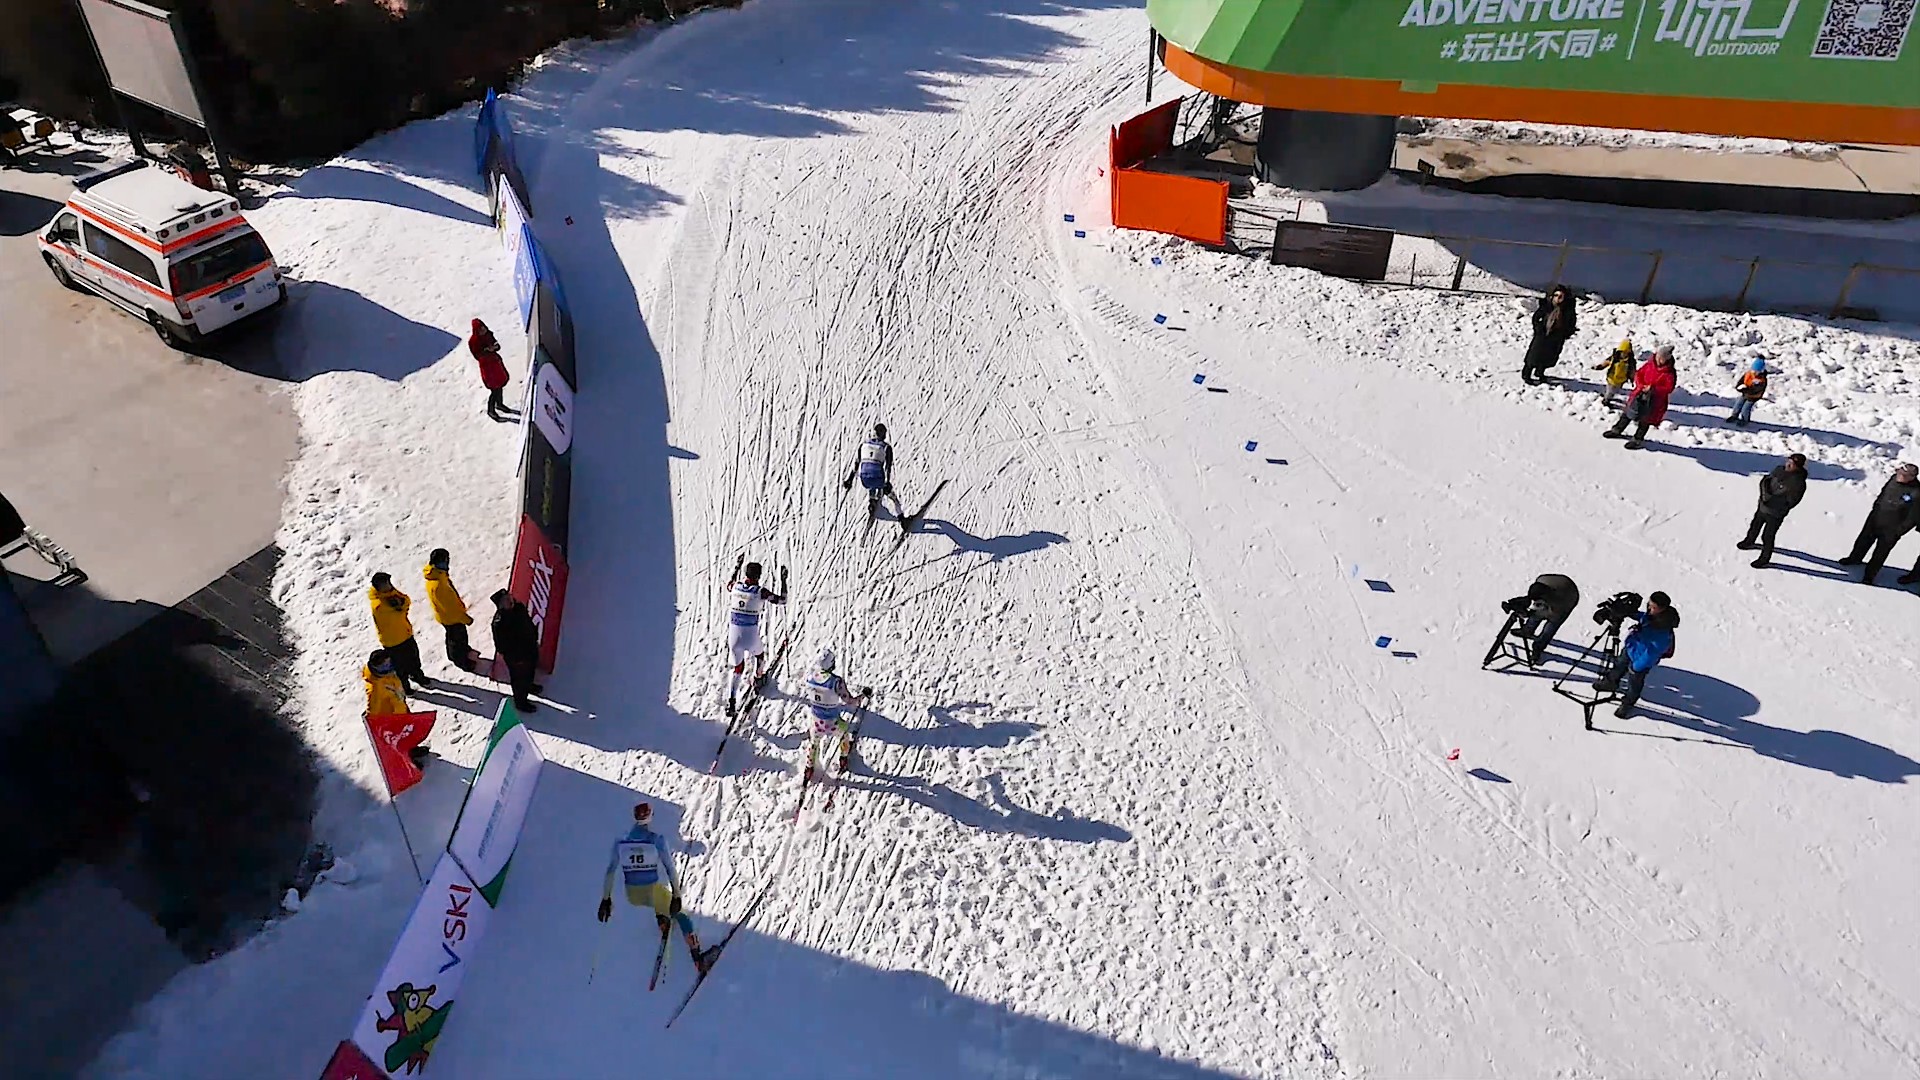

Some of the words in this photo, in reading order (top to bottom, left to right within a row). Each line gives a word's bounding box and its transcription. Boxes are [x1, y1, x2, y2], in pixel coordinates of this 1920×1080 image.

[1399, 0, 1624, 27] ADVENTURE
[1440, 28, 1618, 62] #玩出不同#
[1707, 42, 1780, 56] OUTDOOR
